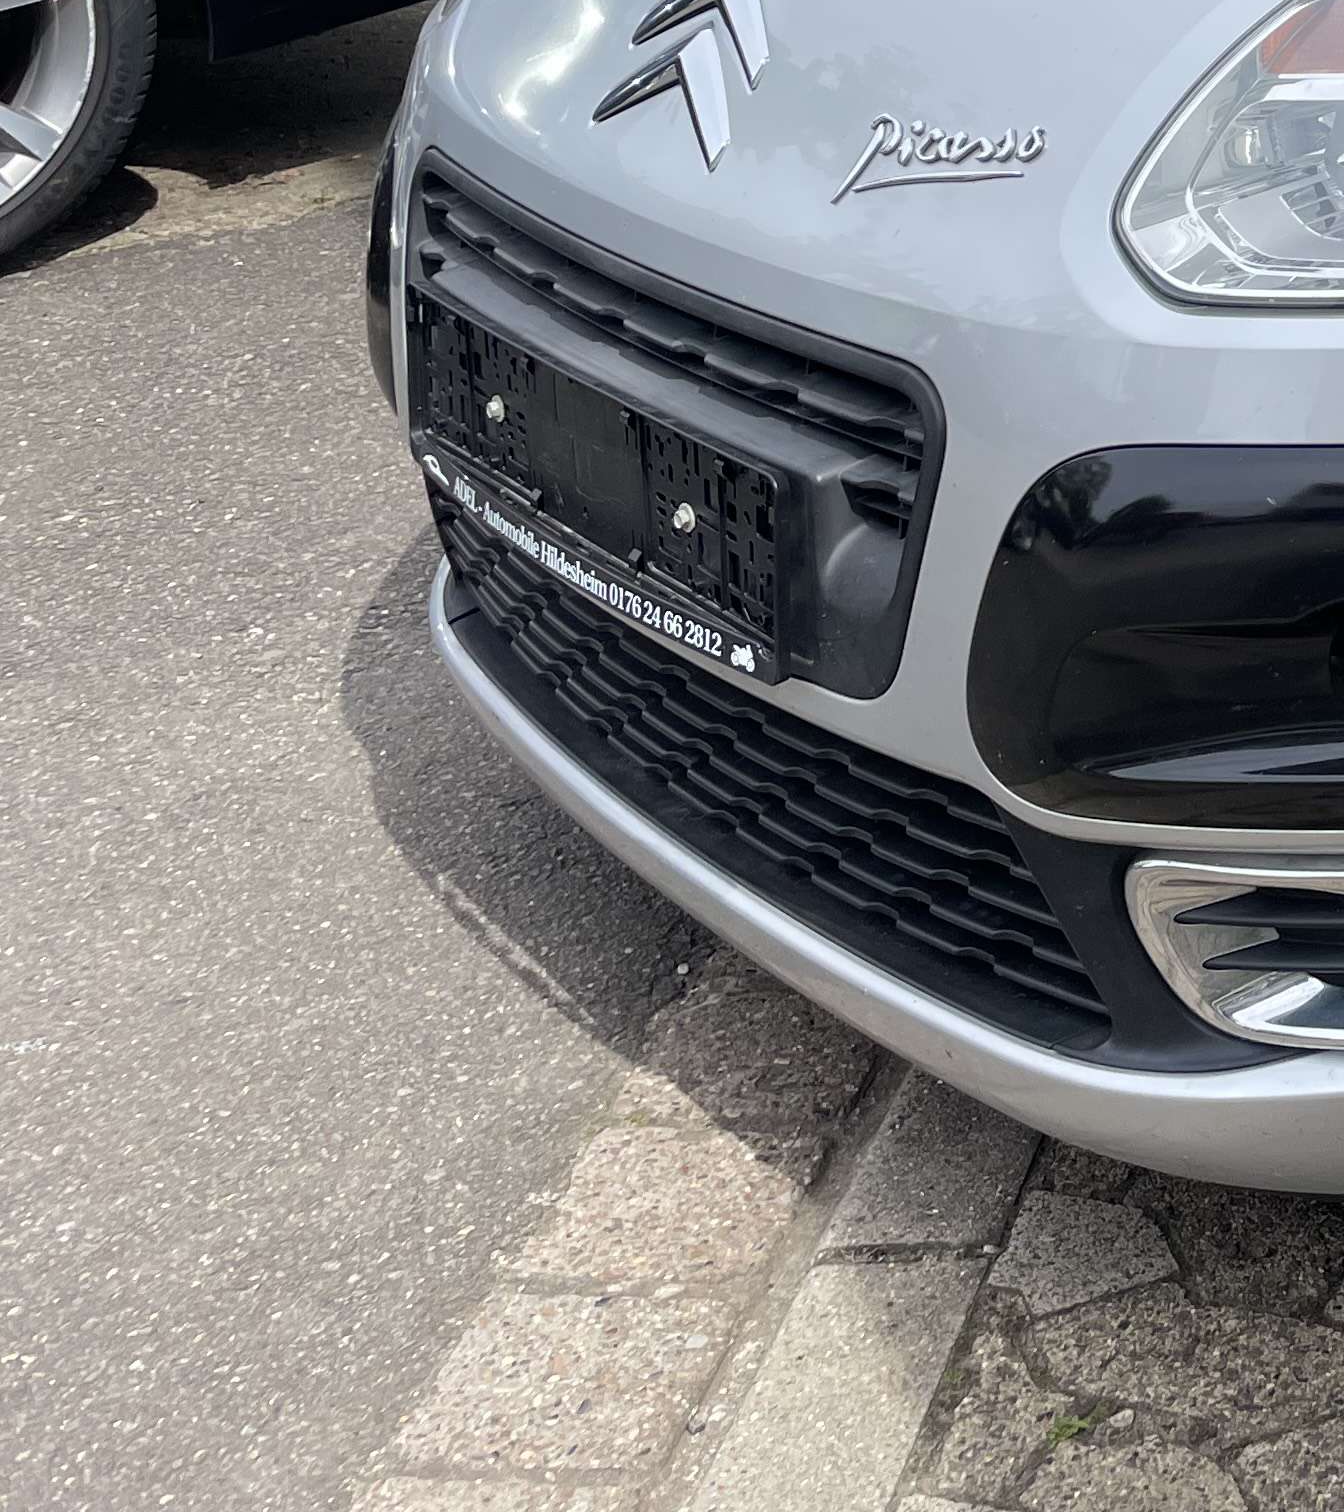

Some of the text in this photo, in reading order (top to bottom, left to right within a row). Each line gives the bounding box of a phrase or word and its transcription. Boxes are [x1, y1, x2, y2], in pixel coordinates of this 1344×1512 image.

[831, 111, 1049, 205] Picasso
[454, 476, 477, 513] ADEL
[483, 501, 540, 559] Automobile
[541, 540, 608, 601] Hildesheim
[609, 582, 642, 619] 0176
[643, 600, 661, 629] 24
[663, 610, 683, 638] 66
[684, 619, 722, 657] 2812
